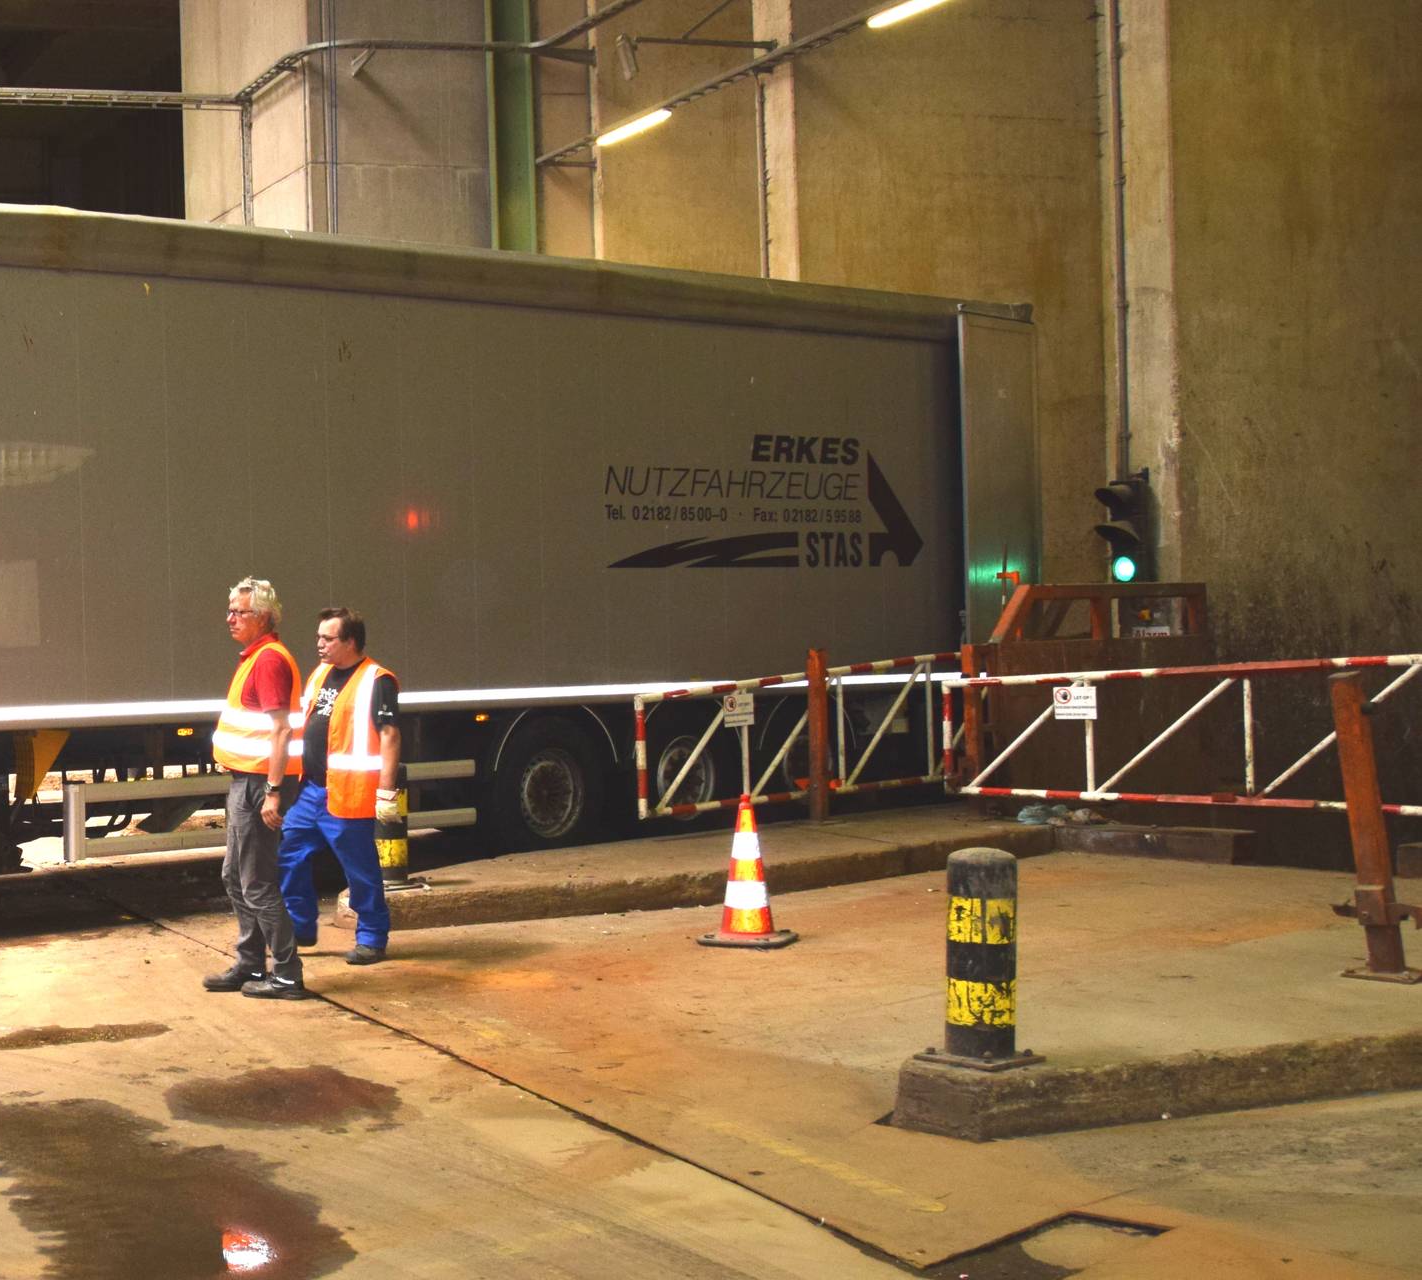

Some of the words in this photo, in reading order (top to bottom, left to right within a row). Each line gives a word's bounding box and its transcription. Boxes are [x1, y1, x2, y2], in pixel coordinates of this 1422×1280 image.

[751, 433, 861, 465] ERKES
[604, 465, 861, 501] NUTZFAHRZEUGE
[605, 504, 626, 520] Tel.
[753, 507, 777, 522] Fax:
[806, 531, 862, 568] STAS
